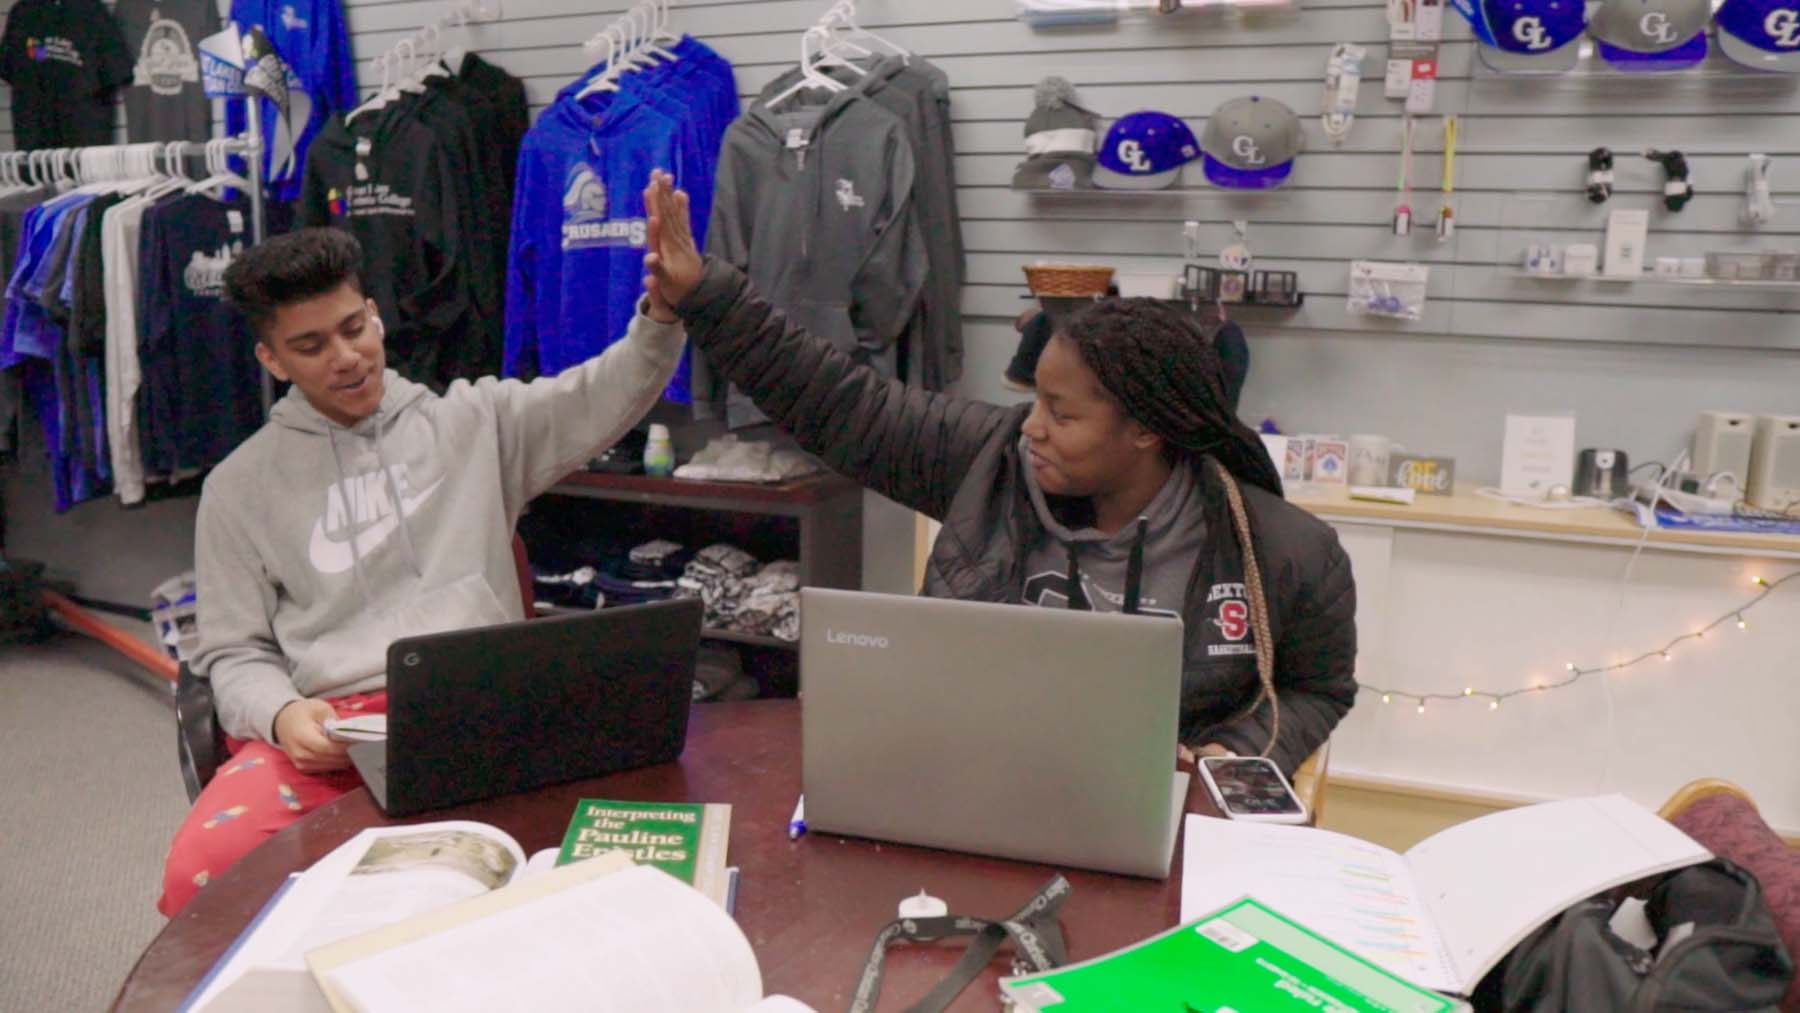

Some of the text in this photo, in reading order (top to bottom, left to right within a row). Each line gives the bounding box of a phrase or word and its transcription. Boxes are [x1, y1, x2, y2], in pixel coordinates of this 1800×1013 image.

[1513, 16, 1552, 49] GL
[1640, 12, 1677, 43] GL
[1764, 8, 1800, 47] GL
[1118, 139, 1150, 171] GL
[1232, 135, 1265, 164] GL
[326, 463, 408, 532] NIKE
[826, 626, 888, 649] Lenovo
[587, 805, 697, 824] Interpreting
[594, 818, 625, 830] the
[578, 828, 684, 845] Pauline
